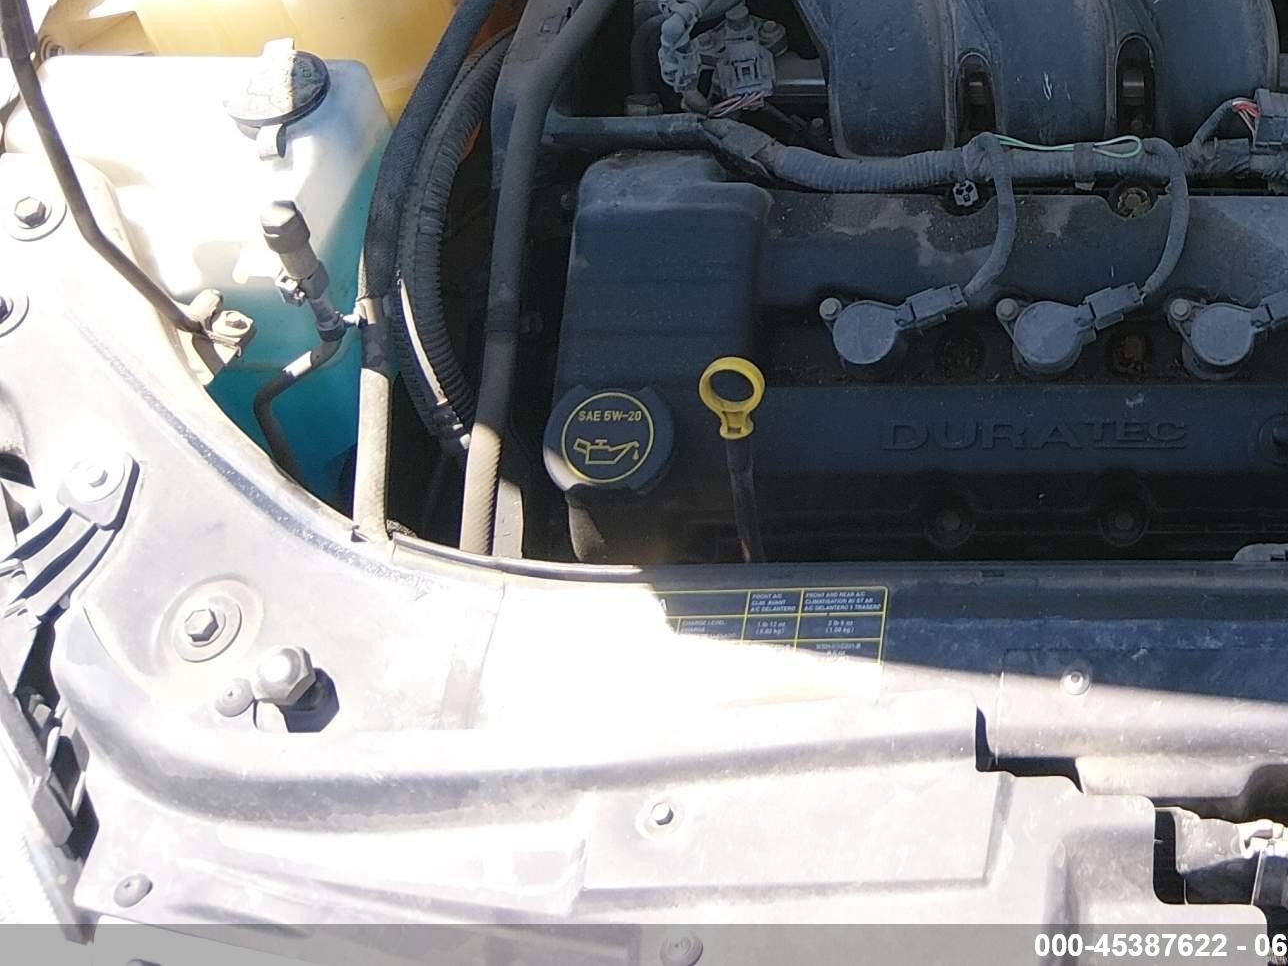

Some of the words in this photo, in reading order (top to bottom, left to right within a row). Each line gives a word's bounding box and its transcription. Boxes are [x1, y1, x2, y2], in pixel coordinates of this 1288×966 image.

[578, 410, 600, 422] SAE
[603, 410, 642, 422] 5W-20
[881, 420, 1188, 451] DURATEC
